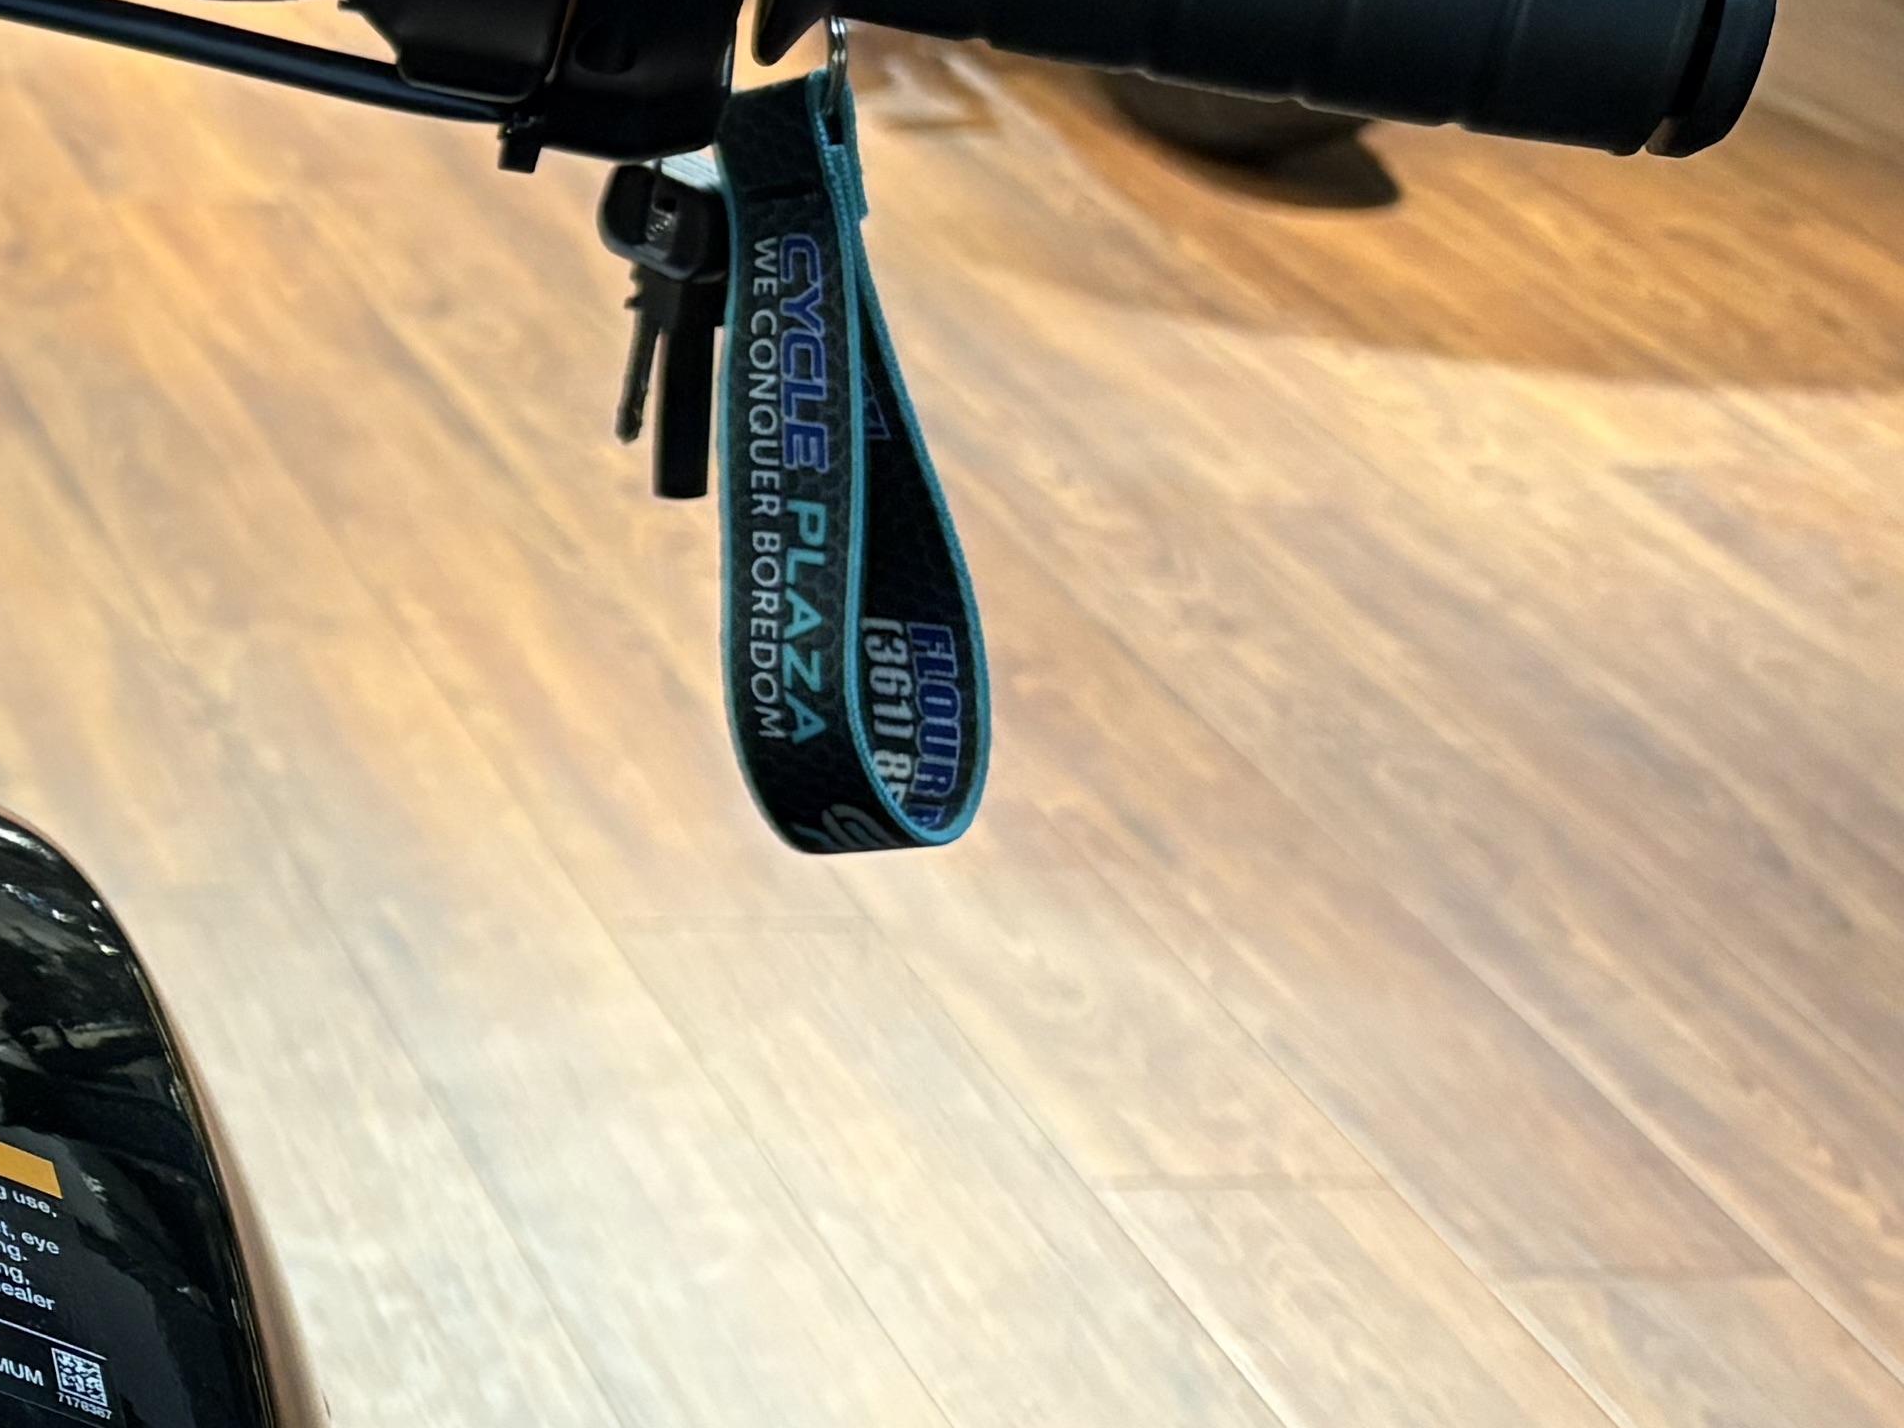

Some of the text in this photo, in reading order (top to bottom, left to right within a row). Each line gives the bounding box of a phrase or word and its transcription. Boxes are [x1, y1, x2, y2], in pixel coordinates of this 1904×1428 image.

[748, 236, 786, 739] WE CONQUER BOREDOM
[780, 233, 829, 744] CYCLE PLAZA
[21, 1231, 60, 1255] eye
